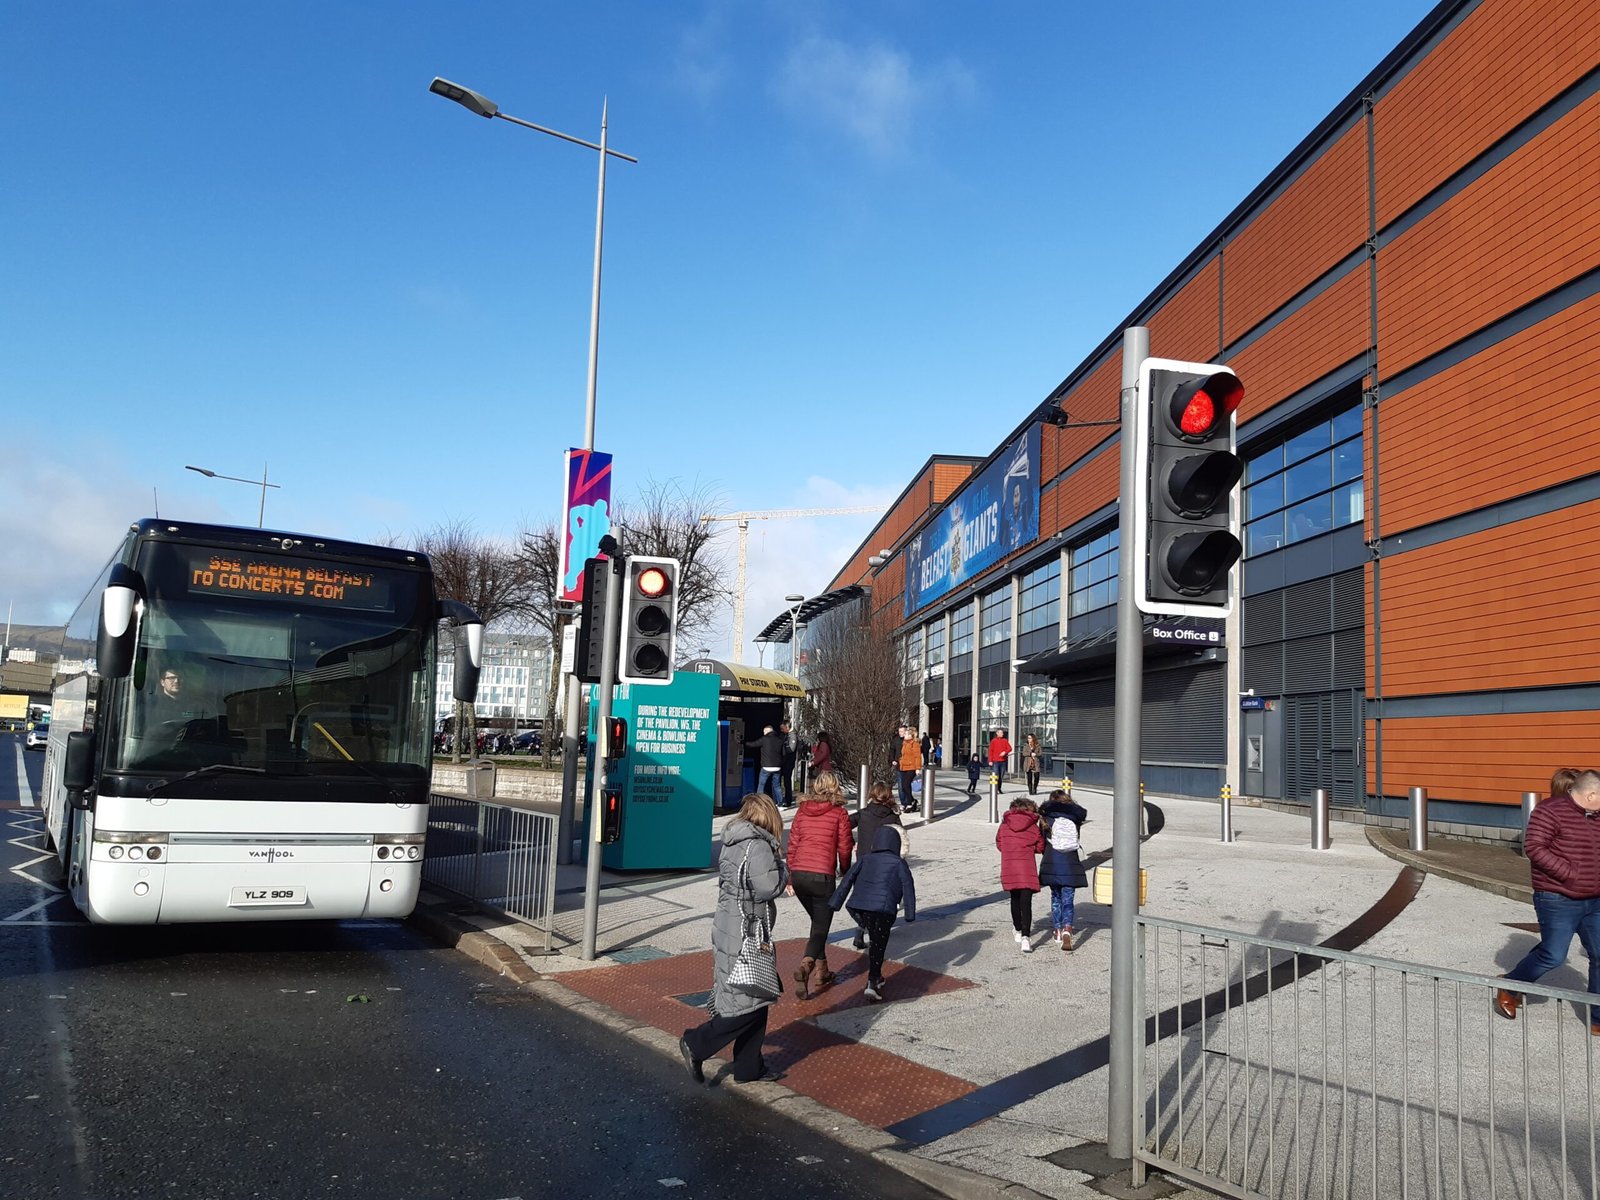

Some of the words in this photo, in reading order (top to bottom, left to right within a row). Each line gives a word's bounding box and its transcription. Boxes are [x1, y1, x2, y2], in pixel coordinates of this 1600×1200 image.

[963, 501, 998, 562] GIANTS
[209, 556, 241, 573] SSE
[247, 561, 301, 579] ARENA
[306, 566, 374, 587] BELFAST
[921, 541, 949, 591] BELFAST
[193, 570, 214, 586] TO
[1152, 627, 1172, 638] Box
[1174, 629, 1207, 641] Office
[739, 676, 750, 685] PAY
[749, 678, 770, 688] STATION
[774, 682, 783, 690] PAY
[783, 683, 802, 692] STATION
[638, 705, 657, 716] DURING
[658, 705, 668, 717] THE
[668, 706, 710, 719] REDEVELOPMENT
[637, 717, 644, 728] OF
[645, 717, 654, 729] THE
[692, 719, 701, 731] THE
[636, 729, 656, 741] CINEMA
[657, 730, 662, 741] &
[663, 730, 687, 742] BOWLING
[687, 731, 697, 742] ARE
[635, 741, 650, 753] OPEN
[650, 742, 660, 753] FOR
[661, 742, 686, 754] BUSINESS
[634, 764, 643, 774] FOR
[643, 765, 657, 775] MORE
[657, 765, 668, 775] INFO
[245, 891, 267, 899] YLZ
[271, 890, 294, 899] 909
